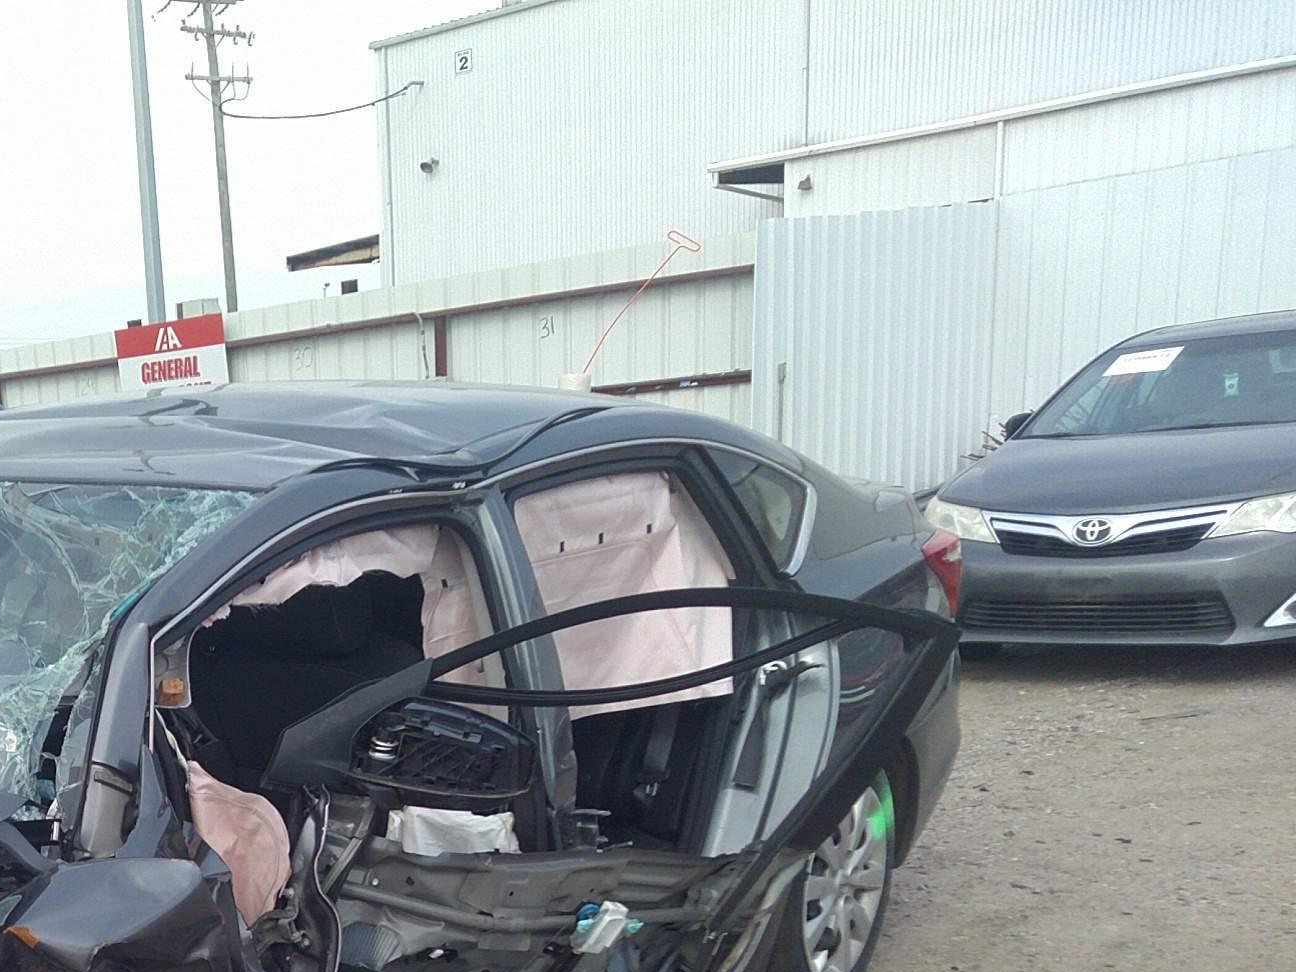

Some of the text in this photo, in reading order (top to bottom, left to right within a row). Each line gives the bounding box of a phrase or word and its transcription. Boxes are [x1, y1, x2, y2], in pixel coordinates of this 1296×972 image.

[459, 56, 468, 71] 2
[538, 315, 555, 339] 31
[141, 355, 201, 384] GENERAL
